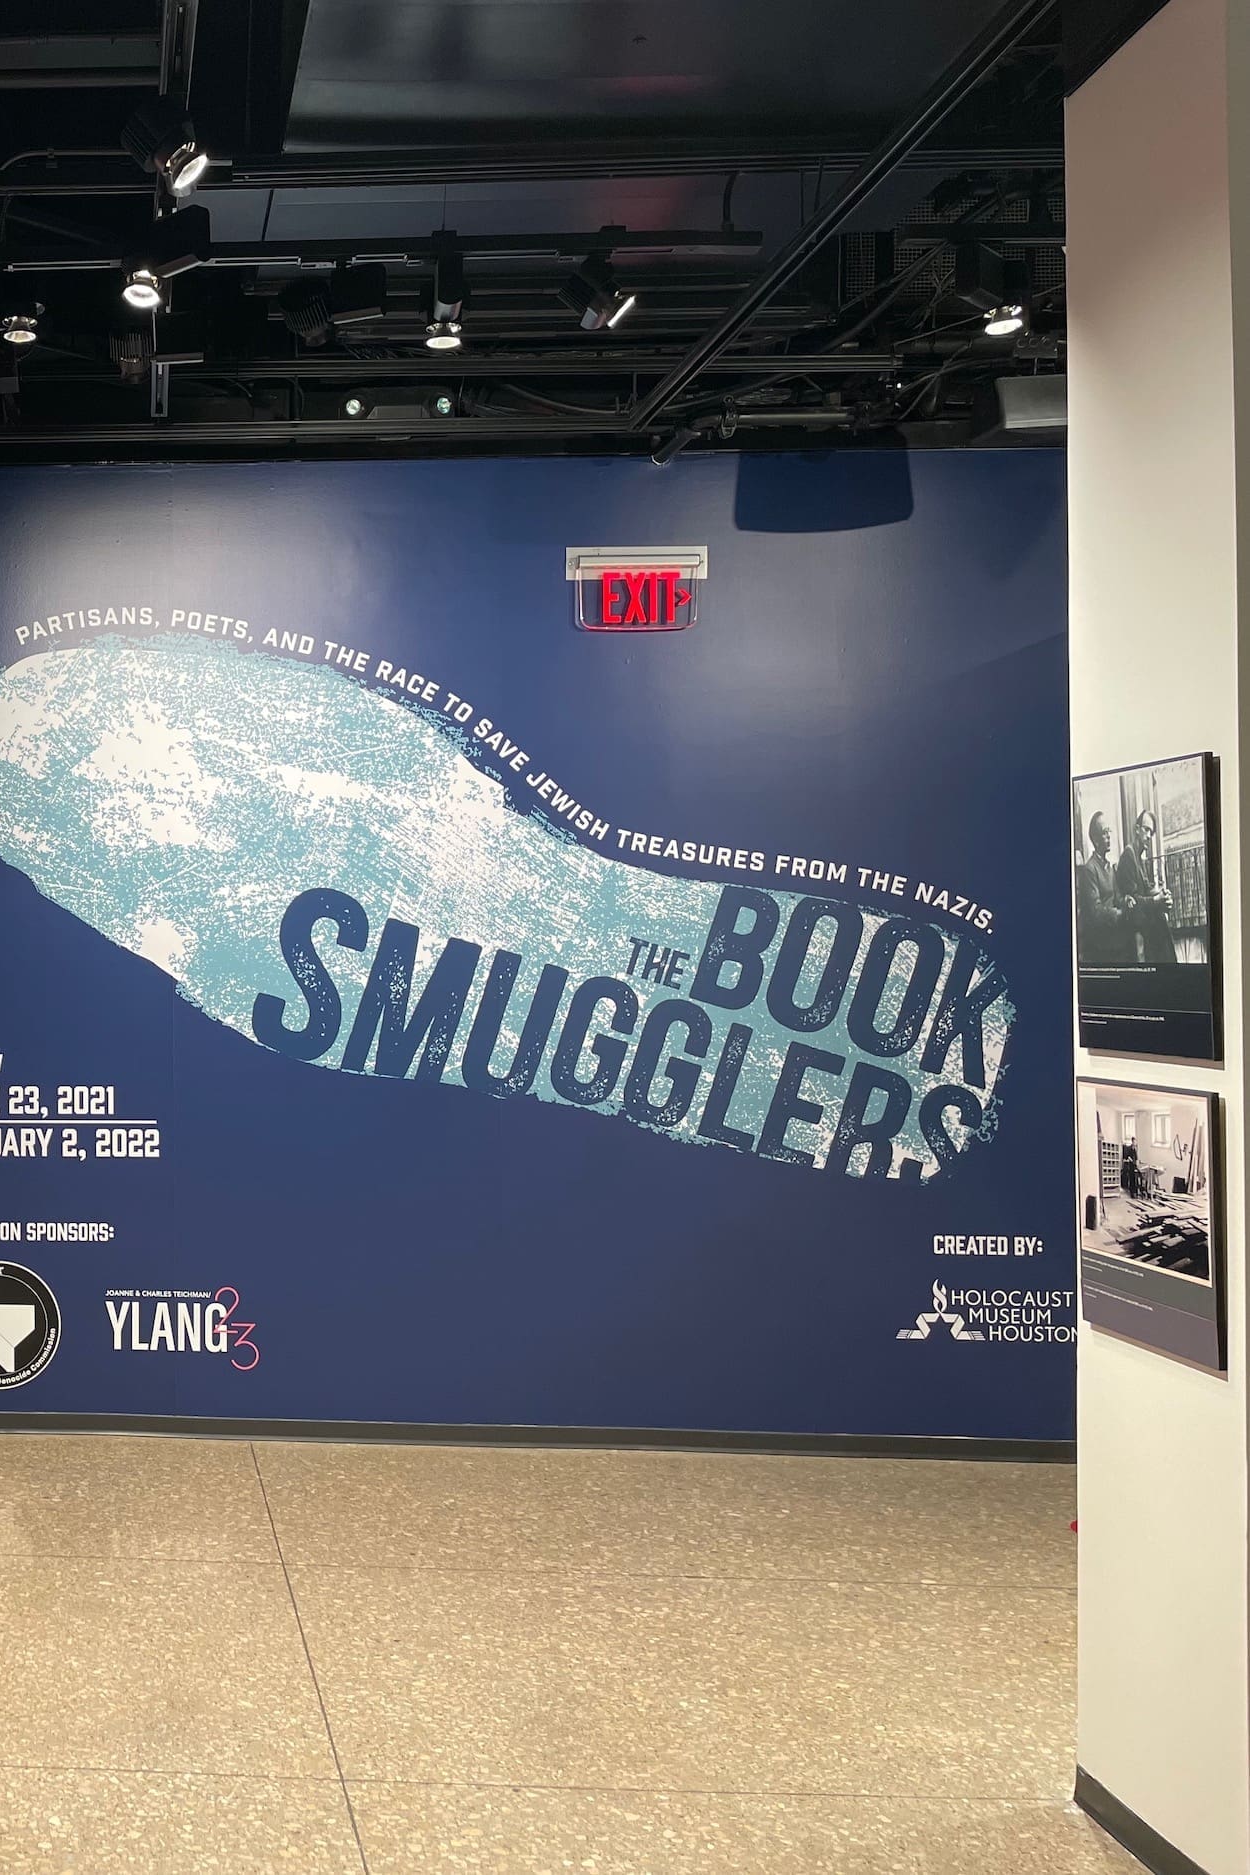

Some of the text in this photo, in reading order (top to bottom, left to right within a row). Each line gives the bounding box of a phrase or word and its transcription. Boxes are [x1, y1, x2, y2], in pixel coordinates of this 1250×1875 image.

[602, 572, 680, 623] EXIT
[15, 607, 994, 935] PARTISANS, POETS, AND THE RACE TO SAVE JEWISH TREASURES FROM THE NAZIS.
[628, 885, 1008, 1090] THE BOOK
[251, 887, 985, 1184] SMUGGLERS
[8, 1086, 48, 1118] 23,
[57, 1086, 115, 1115] 2021
[62, 1128, 87, 1162] 2,
[96, 1128, 160, 1158] 2022
[26, 1222, 115, 1242] SPONSORS:
[933, 1235, 1044, 1256] CREATED BY:
[105, 1290, 134, 1298] JOANNE
[135, 1290, 140, 1298] &
[142, 1290, 172, 1298] CHARLES
[951, 1289, 1074, 1308] HOLOCAUST
[105, 1301, 228, 1353] YLANG
[968, 1309, 1052, 1324] MUSEUM
[30, 1328, 56, 1372] Commission
